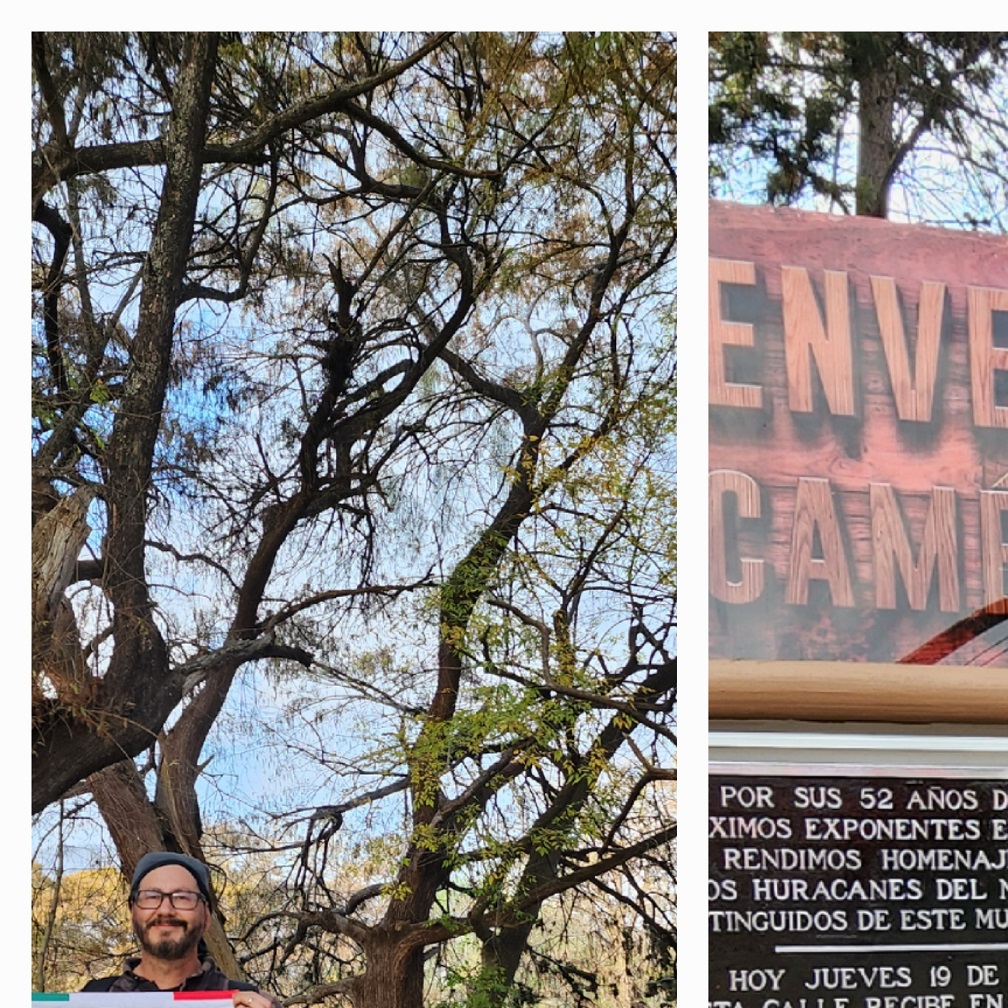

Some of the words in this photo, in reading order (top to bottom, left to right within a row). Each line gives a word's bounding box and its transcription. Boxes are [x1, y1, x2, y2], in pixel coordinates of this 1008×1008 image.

[720, 786, 775, 808] POR
[794, 787, 843, 809] SUS
[859, 788, 894, 810] 52
[906, 786, 979, 811] AÑOS
[709, 816, 793, 839] XIMOS
[804, 818, 981, 841] EXPONENTES
[723, 848, 863, 871] RENDIMOS
[752, 878, 923, 901] HURACANES
[935, 878, 988, 900] DEL
[709, 909, 849, 932] TINGUIDOS
[857, 909, 892, 931] DE
[900, 908, 967, 931] ESTE
[729, 968, 786, 992] HOY
[804, 966, 912, 990] JUEVES
[930, 965, 952, 988] 19
[967, 964, 1000, 987] DE
